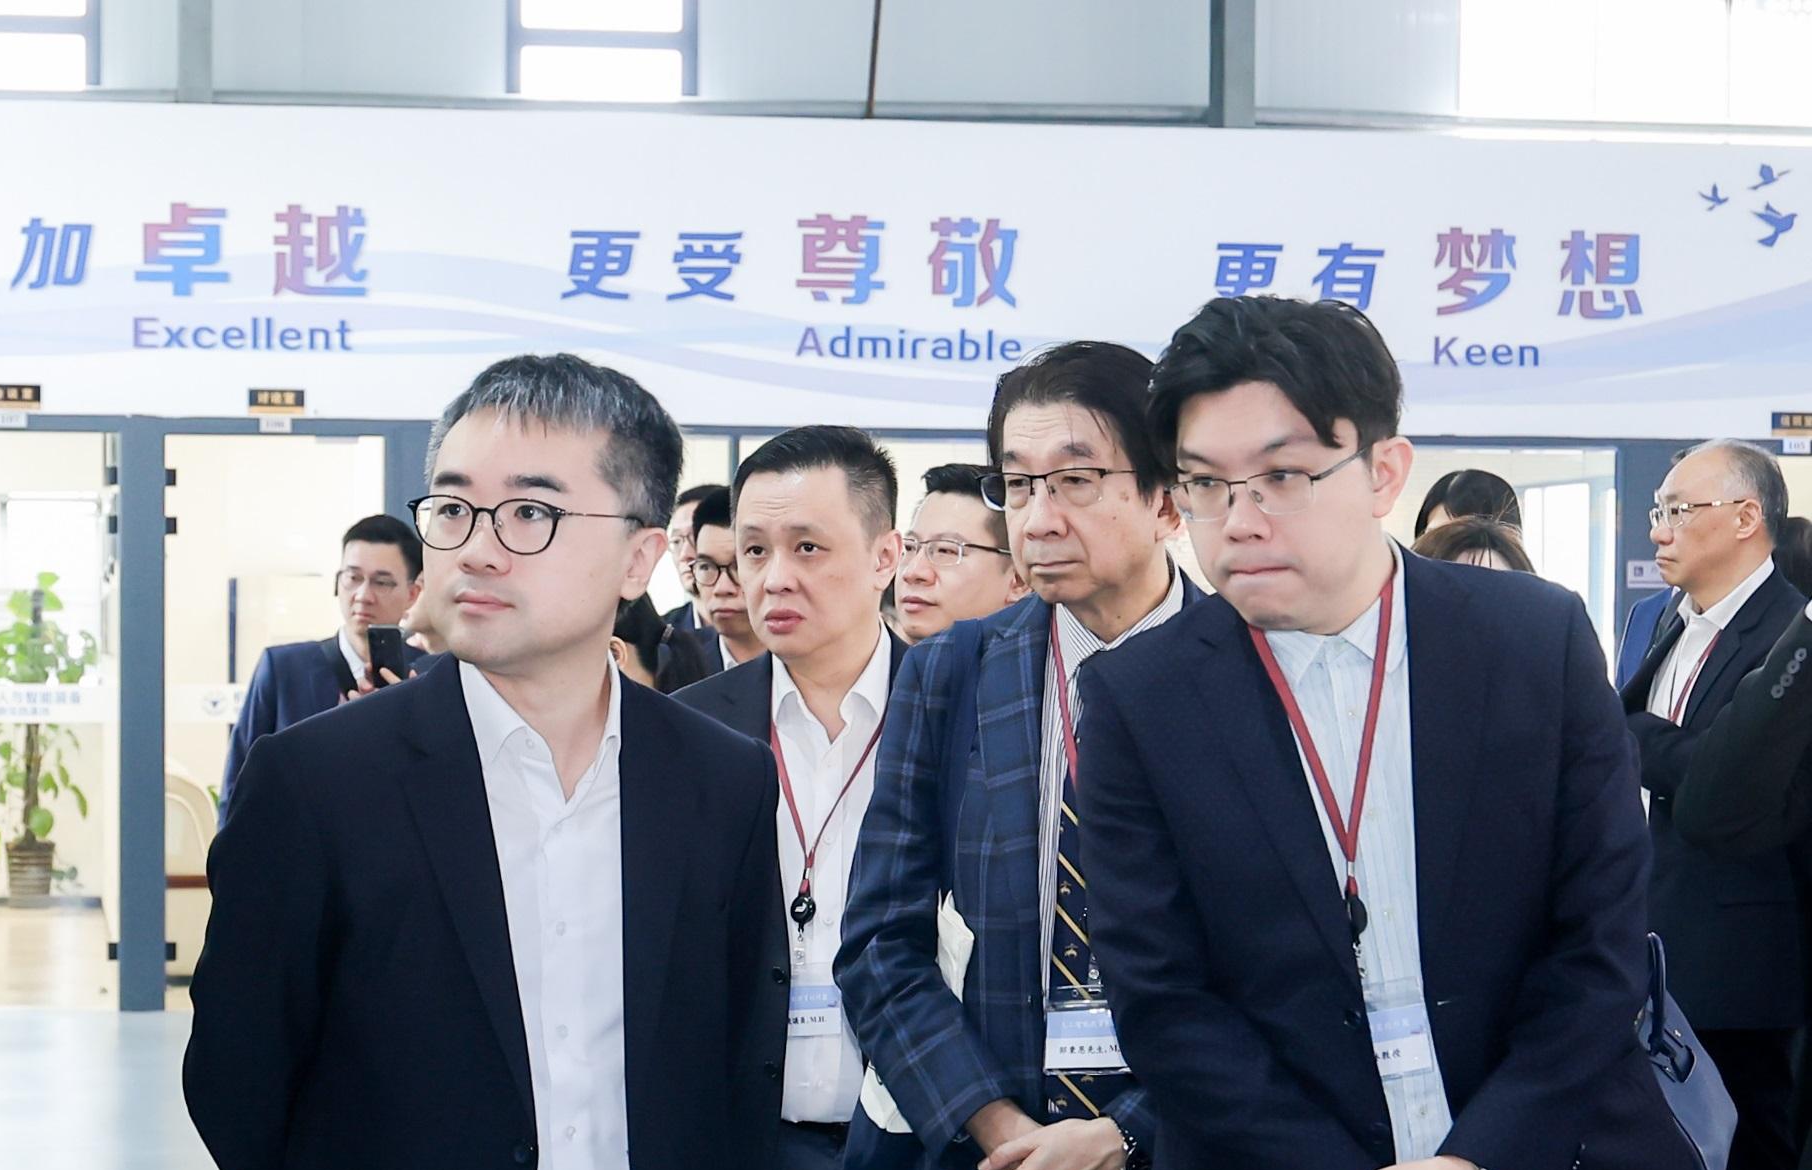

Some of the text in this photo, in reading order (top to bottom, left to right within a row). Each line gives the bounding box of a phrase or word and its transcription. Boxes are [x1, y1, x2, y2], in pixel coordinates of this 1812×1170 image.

[560, 213, 1020, 308] 更受尊敬
[1213, 227, 1644, 319] 更有梦想
[133, 316, 353, 352] Excellent
[796, 326, 1022, 362] Admirable
[1433, 336, 1541, 367] Keen
